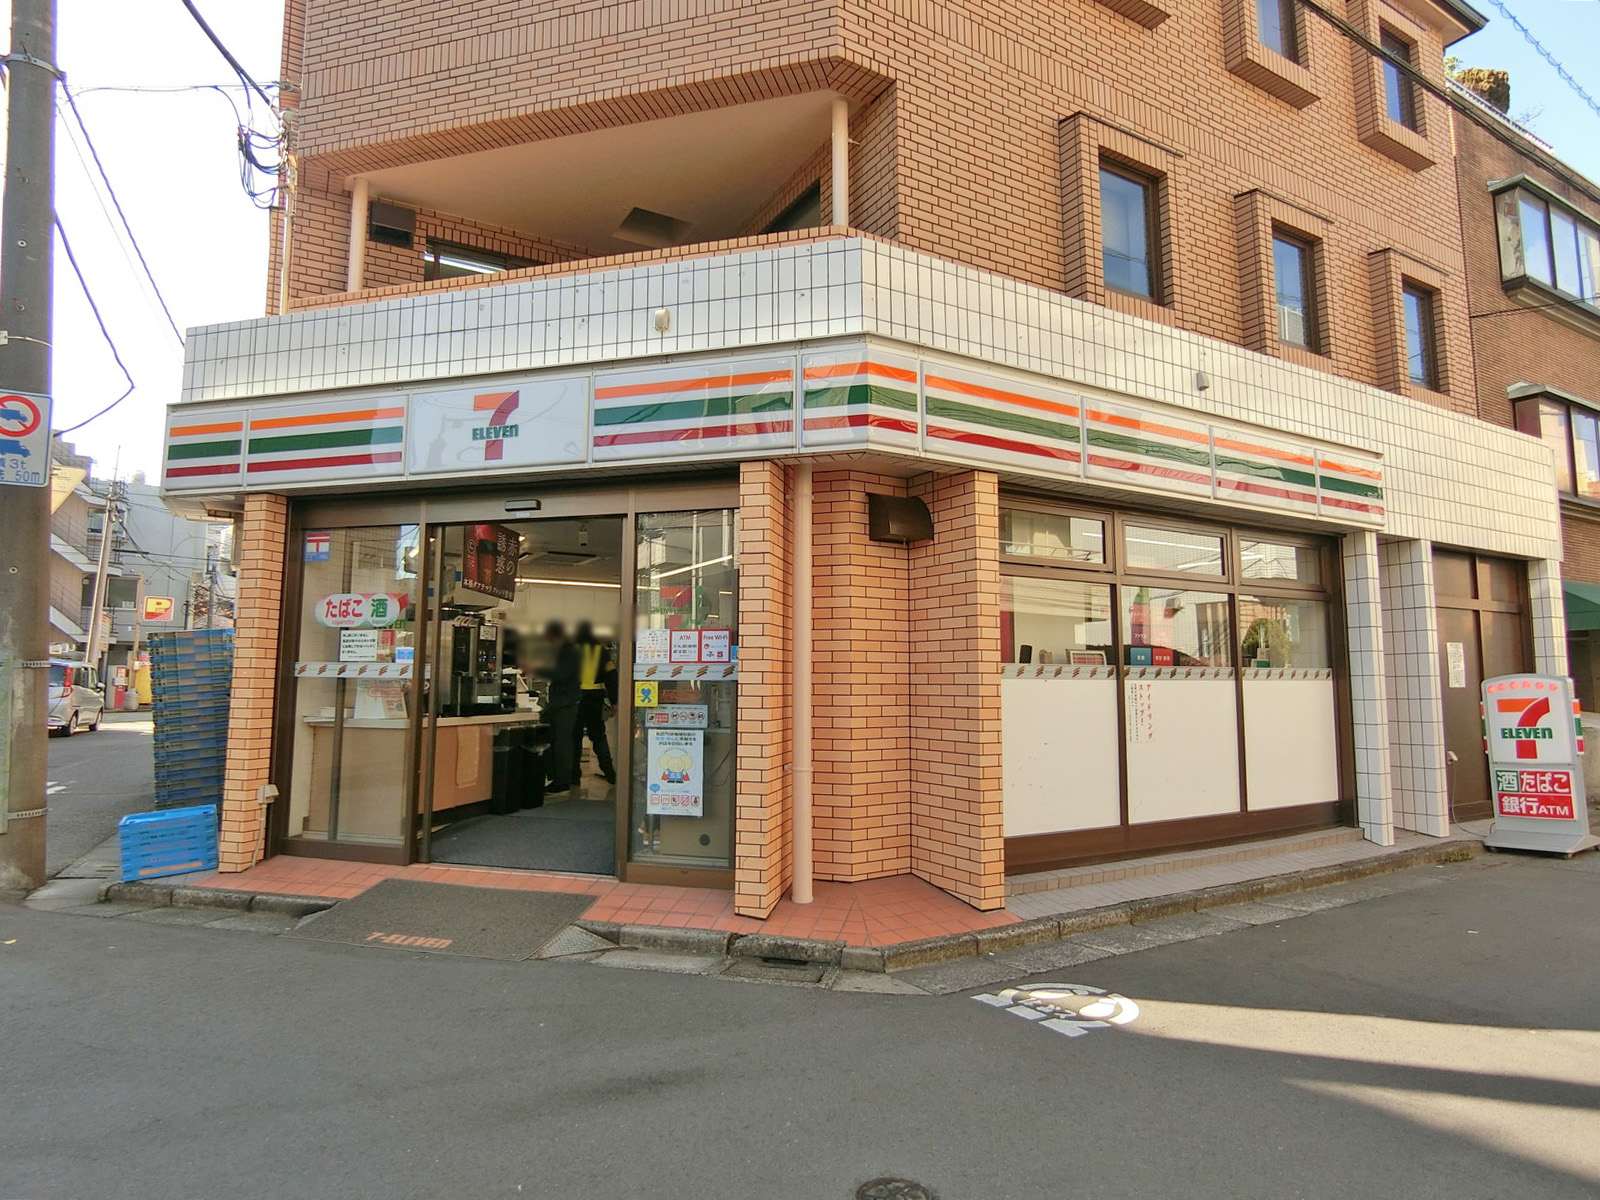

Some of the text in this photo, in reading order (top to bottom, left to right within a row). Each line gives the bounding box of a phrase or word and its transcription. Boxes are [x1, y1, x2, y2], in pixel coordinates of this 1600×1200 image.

[473, 390, 519, 461] 7
[10, 458, 28, 470] 3t
[15, 470, 40, 482] 50m
[146, 598, 172, 613] P
[325, 598, 388, 618] たばこ 酒
[1497, 696, 1550, 759] 7
[1497, 771, 1569, 792] 酒 たばこ
